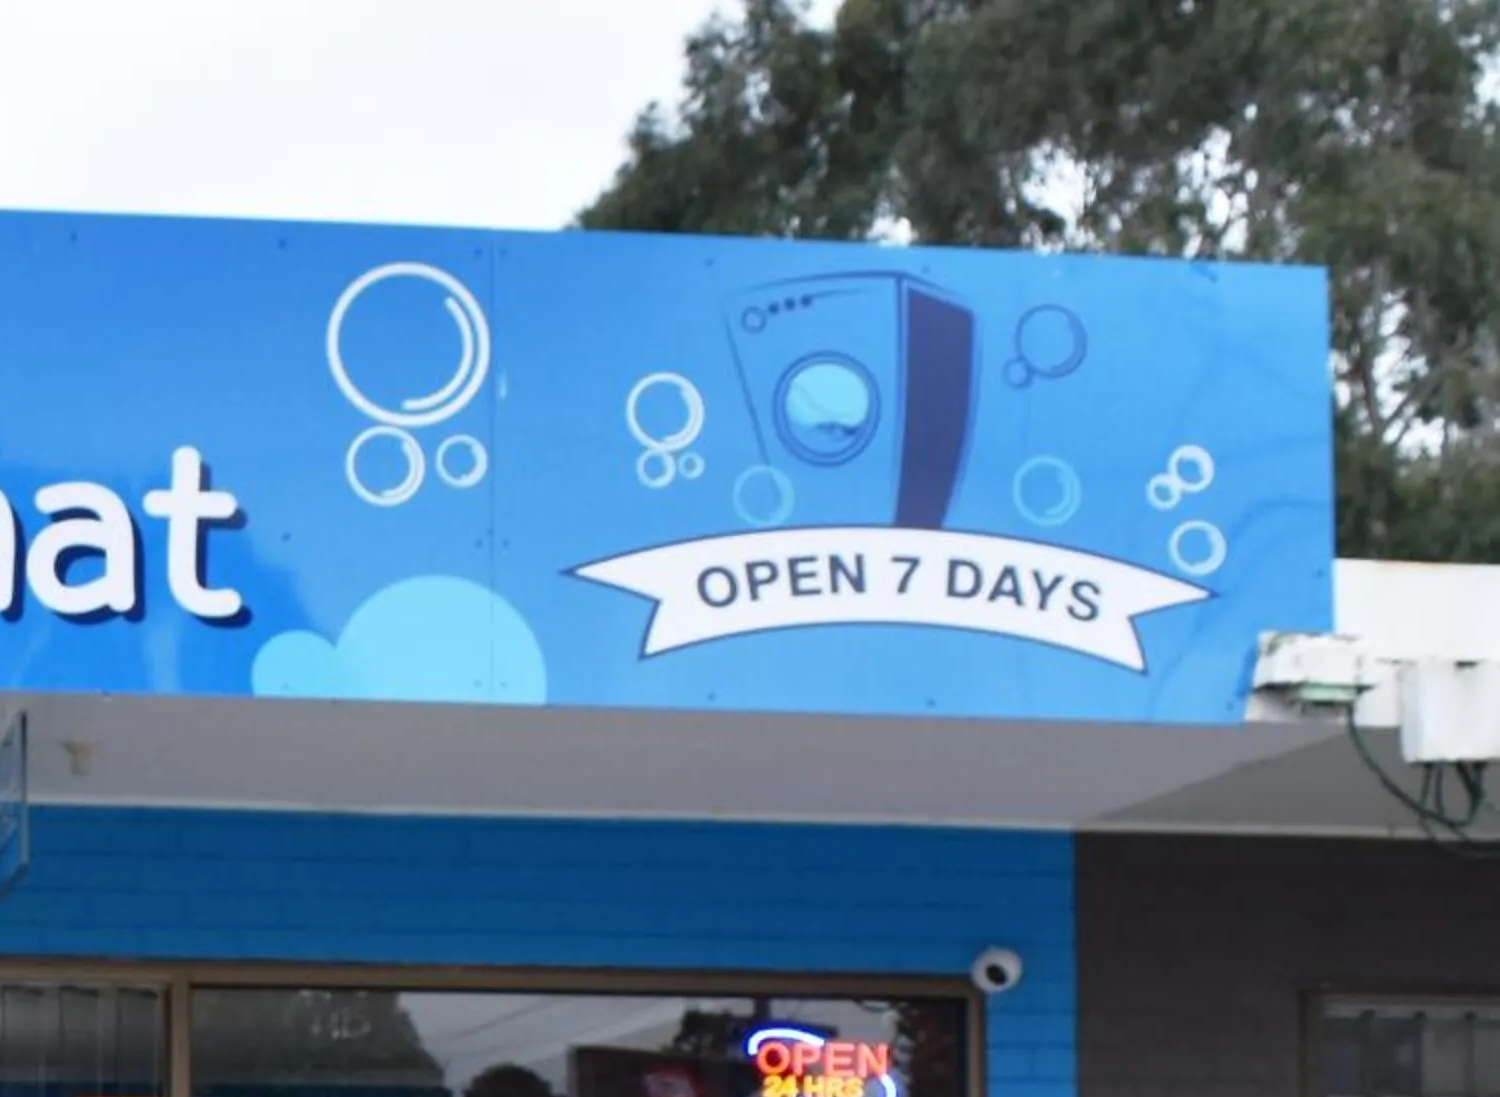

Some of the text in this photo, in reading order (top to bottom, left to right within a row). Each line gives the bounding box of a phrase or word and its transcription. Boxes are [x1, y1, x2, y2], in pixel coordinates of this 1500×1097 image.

[697, 554, 1101, 622] OPEN 7 DAYS
[757, 1041, 889, 1078] OPEN
